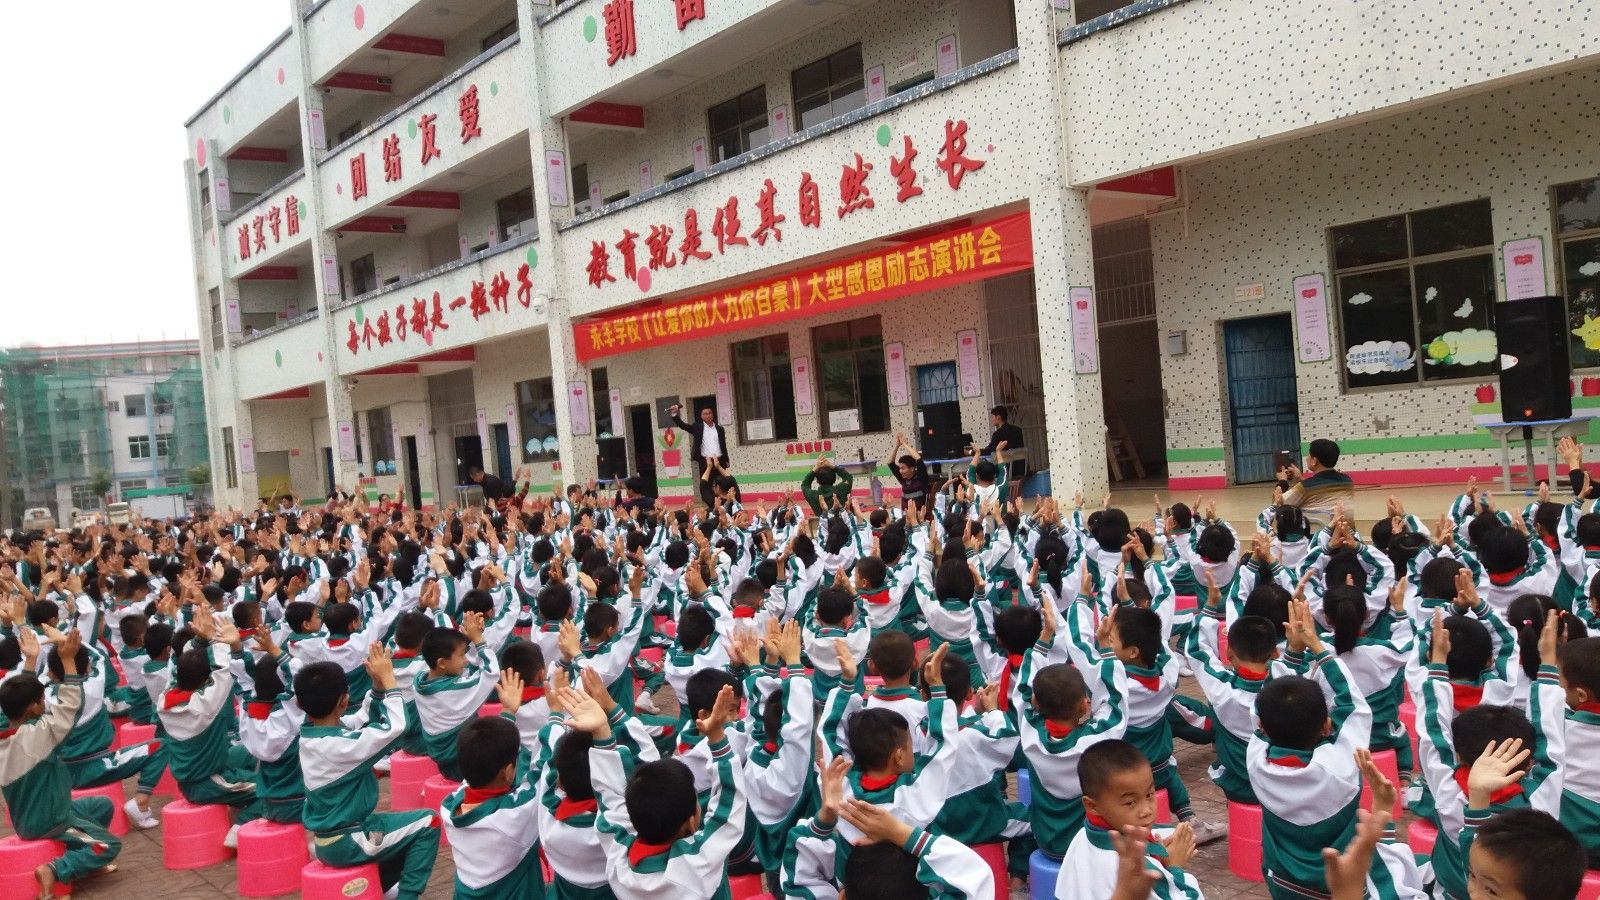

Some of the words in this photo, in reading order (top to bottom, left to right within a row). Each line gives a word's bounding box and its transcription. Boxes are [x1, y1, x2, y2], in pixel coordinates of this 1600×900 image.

[350, 84, 481, 201] 团结友爱
[586, 119, 986, 289] 教育就是促其自然生长
[347, 263, 533, 355] 每个孩子都是一粒种子
